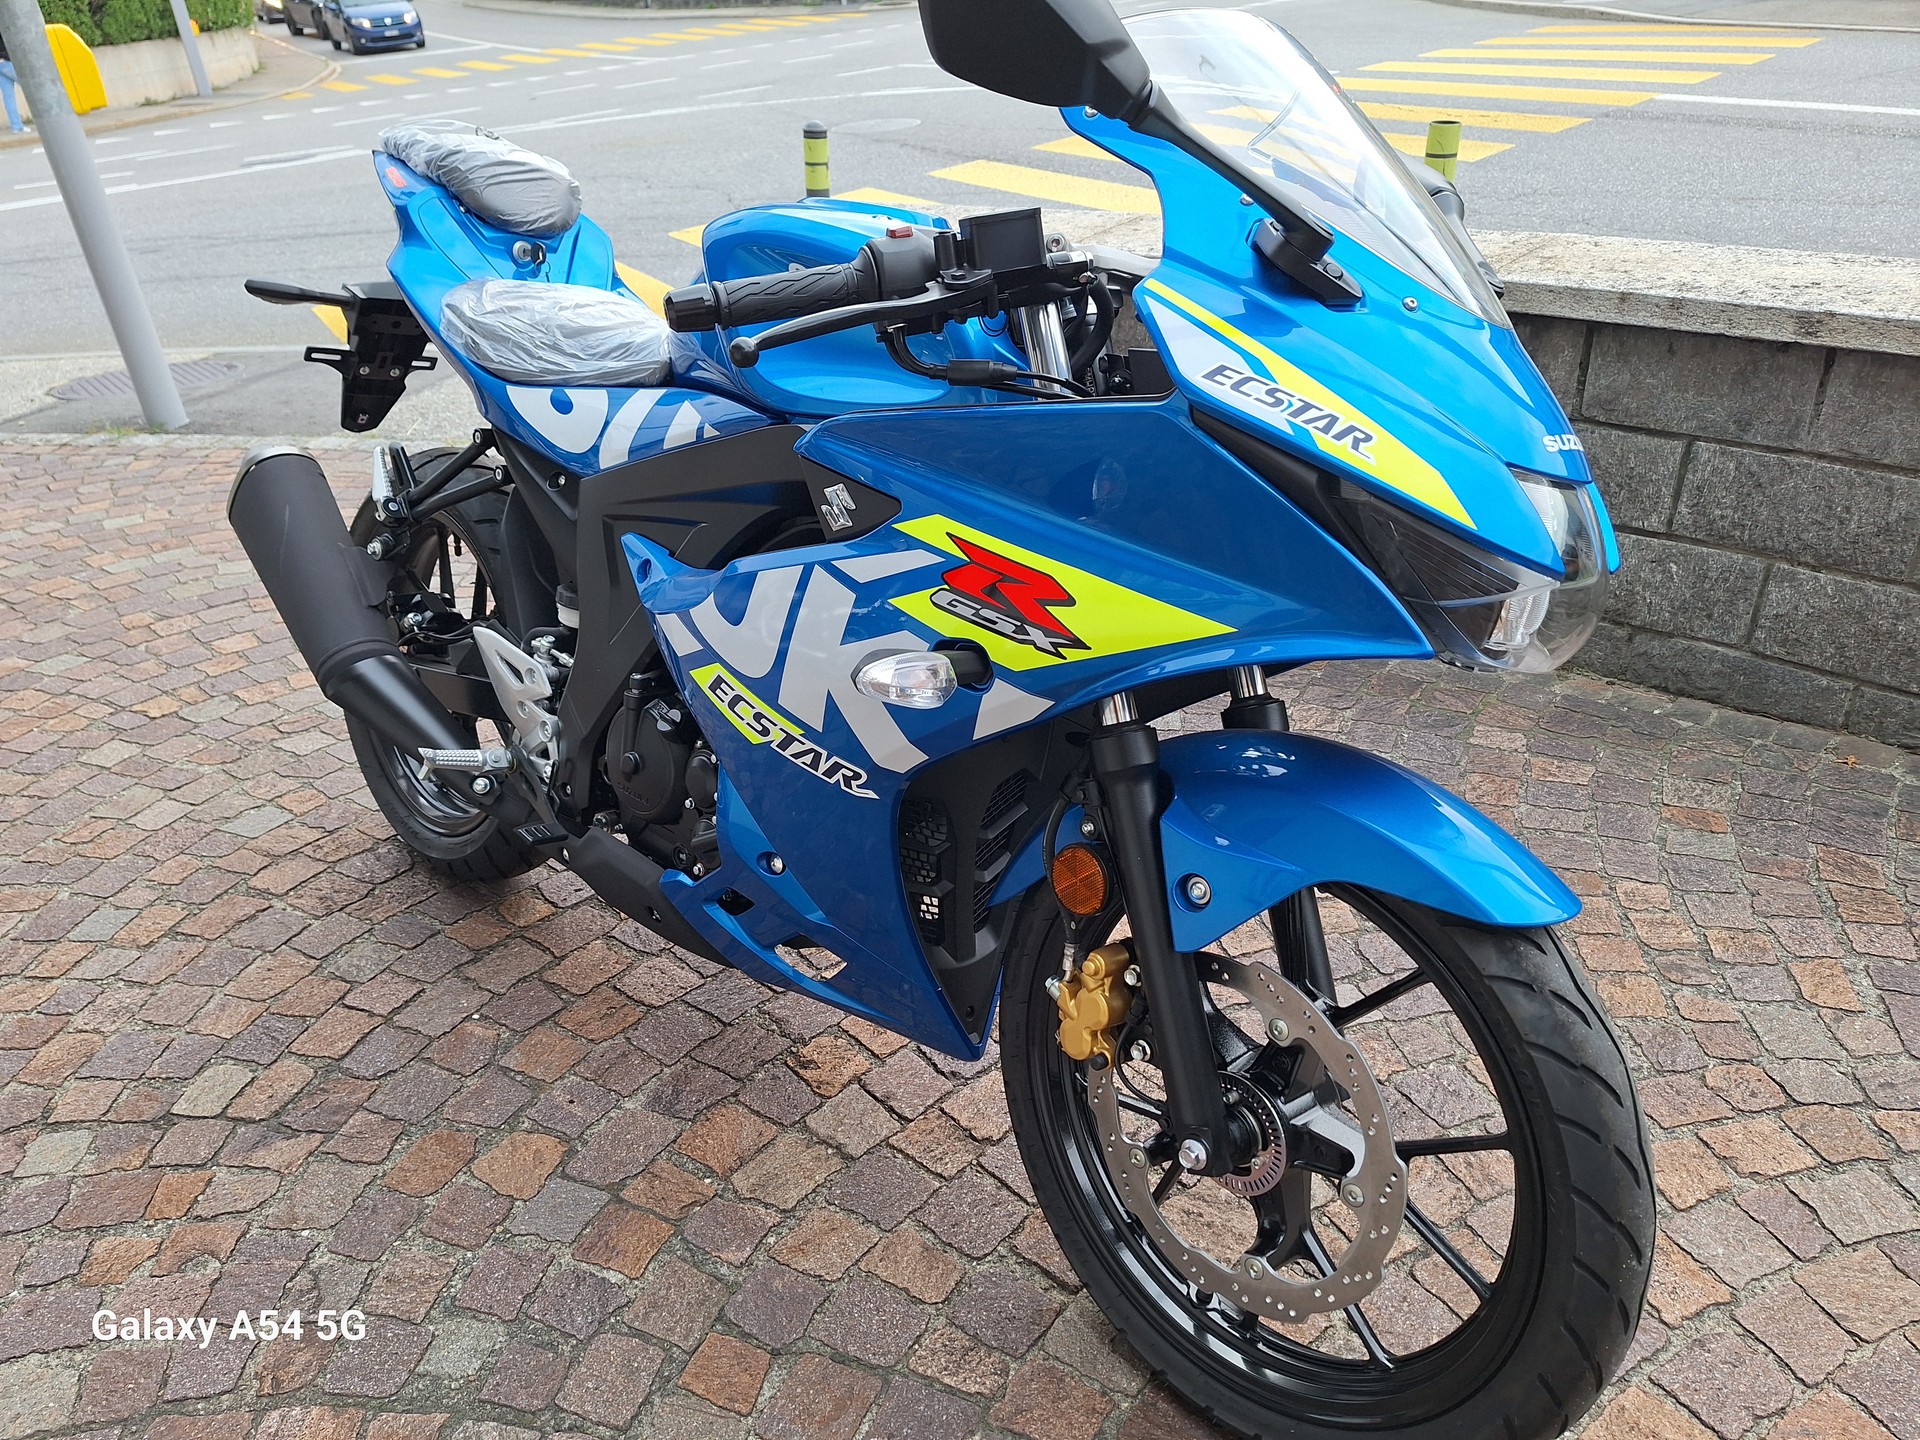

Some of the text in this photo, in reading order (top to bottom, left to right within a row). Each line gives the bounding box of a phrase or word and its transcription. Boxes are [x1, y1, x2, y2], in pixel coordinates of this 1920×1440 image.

[1200, 363, 1377, 463] ECSTAR
[931, 589, 1073, 654] GSX
[706, 672, 878, 798] ECSTAR
